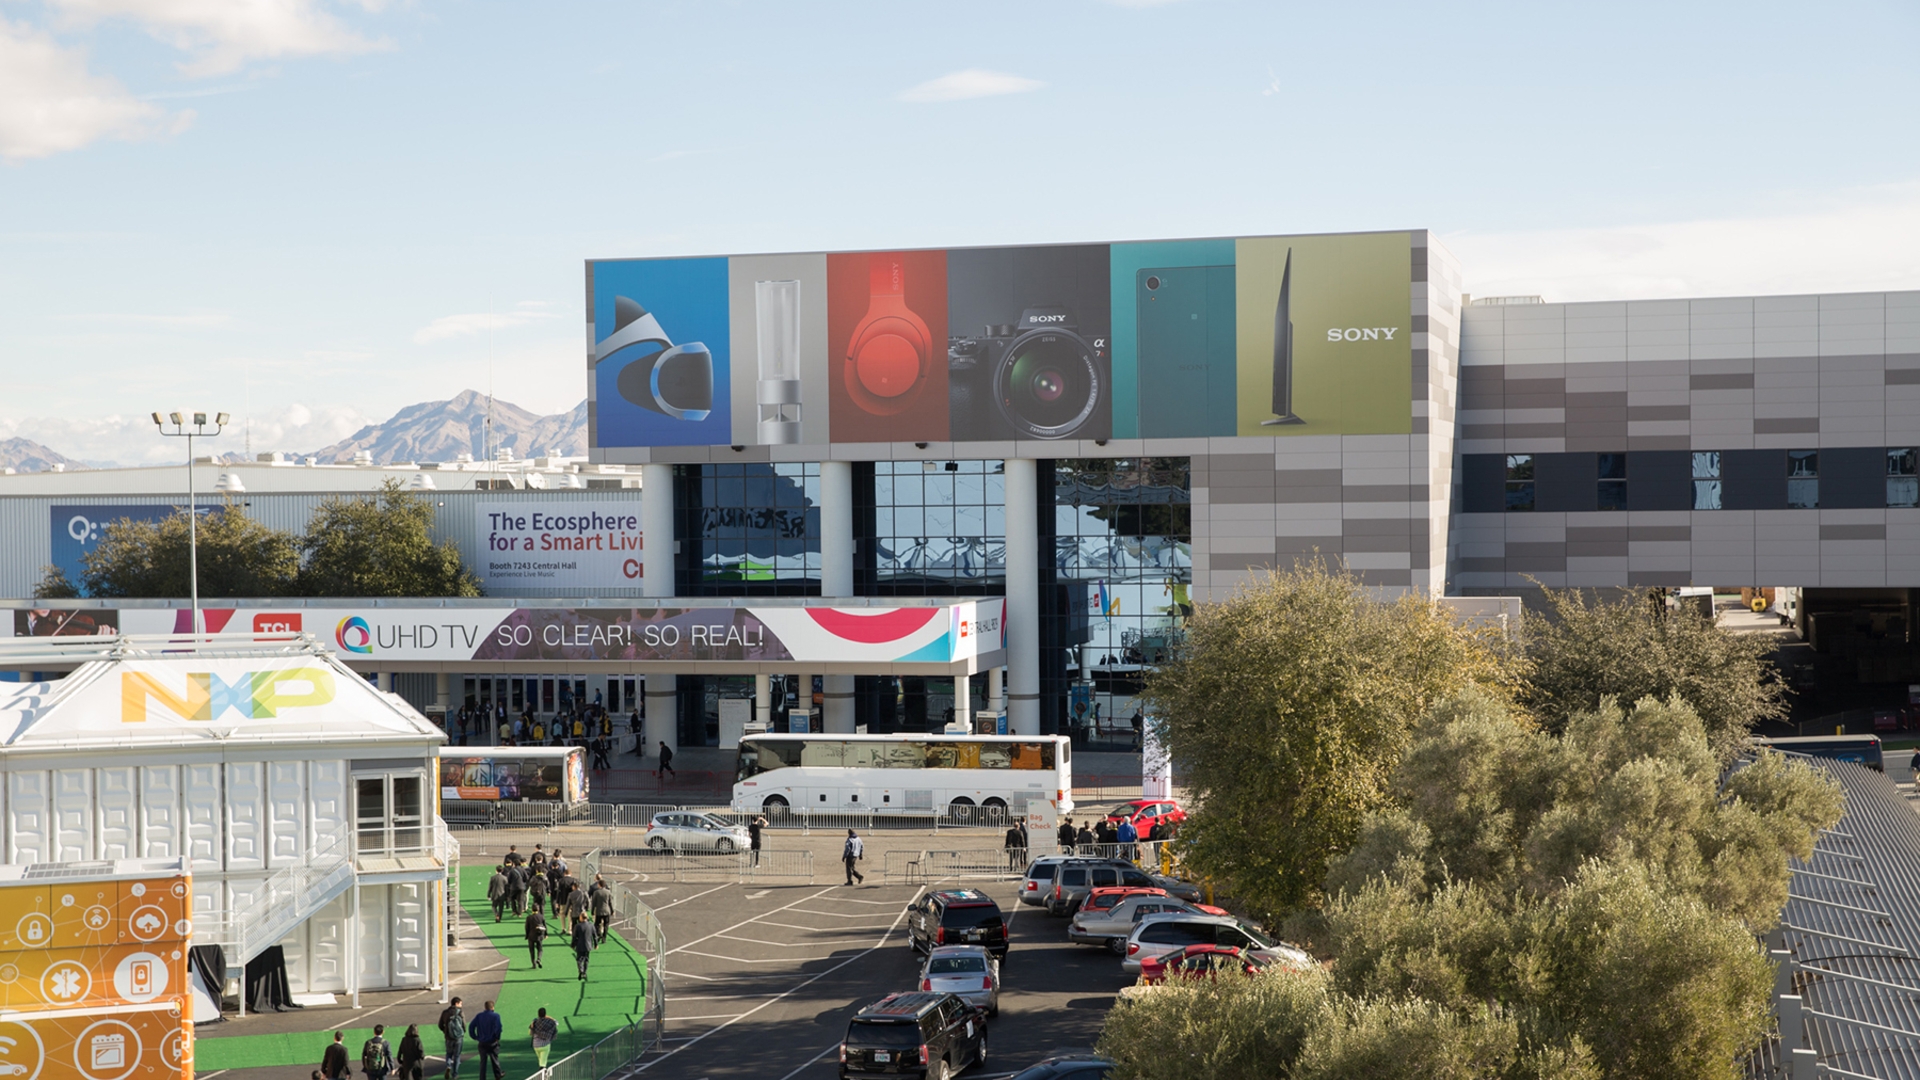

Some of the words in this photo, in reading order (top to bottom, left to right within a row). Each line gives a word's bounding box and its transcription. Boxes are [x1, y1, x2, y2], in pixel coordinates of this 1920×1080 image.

[1029, 315, 1066, 323] SONY
[1327, 327, 1398, 342] SONY
[1179, 363, 1212, 371] SONY
[488, 512, 526, 531] The
[532, 511, 638, 535] Ecosphere
[489, 532, 518, 551] for
[523, 536, 534, 551] a
[540, 532, 603, 551] Smart
[489, 562, 512, 570] Booth
[513, 562, 531, 570] 7243
[533, 562, 560, 570] Central
[561, 562, 577, 570] Hall
[489, 571, 522, 579] Experience
[441, 625, 478, 649] TV
[497, 624, 532, 646] SO
[543, 624, 631, 646] CLEAR!
[644, 624, 680, 646] SO
[691, 624, 764, 646] REAL!
[121, 667, 336, 723] NXP
[1030, 813, 1043, 822] Bag
[1029, 822, 1052, 830] Check
